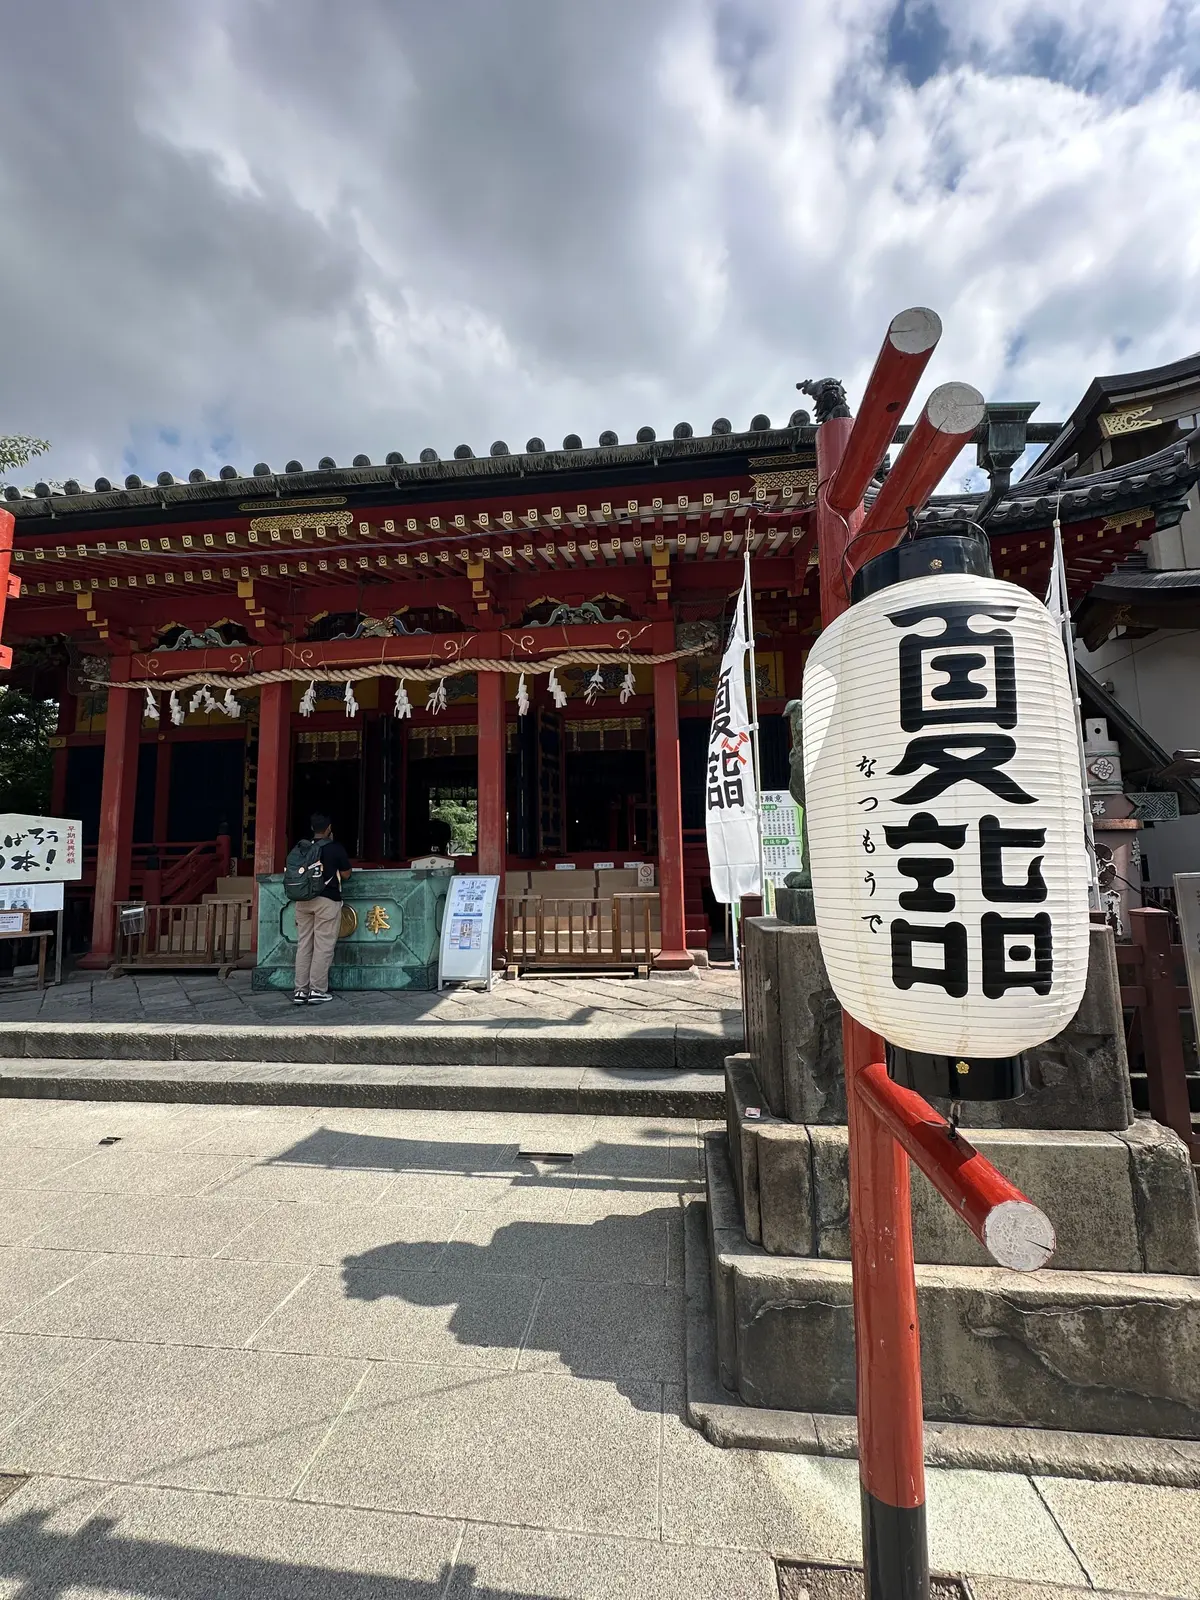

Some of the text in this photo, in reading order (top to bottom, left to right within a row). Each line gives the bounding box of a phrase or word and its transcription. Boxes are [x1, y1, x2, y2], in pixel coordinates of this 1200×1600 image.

[707, 666, 744, 811] 夏詣
[883, 600, 1053, 1000] 夏詣
[0, 827, 58, 850] ばろう
[857, 755, 883, 934] なつもうで
[365, 904, 391, 934] 奉
